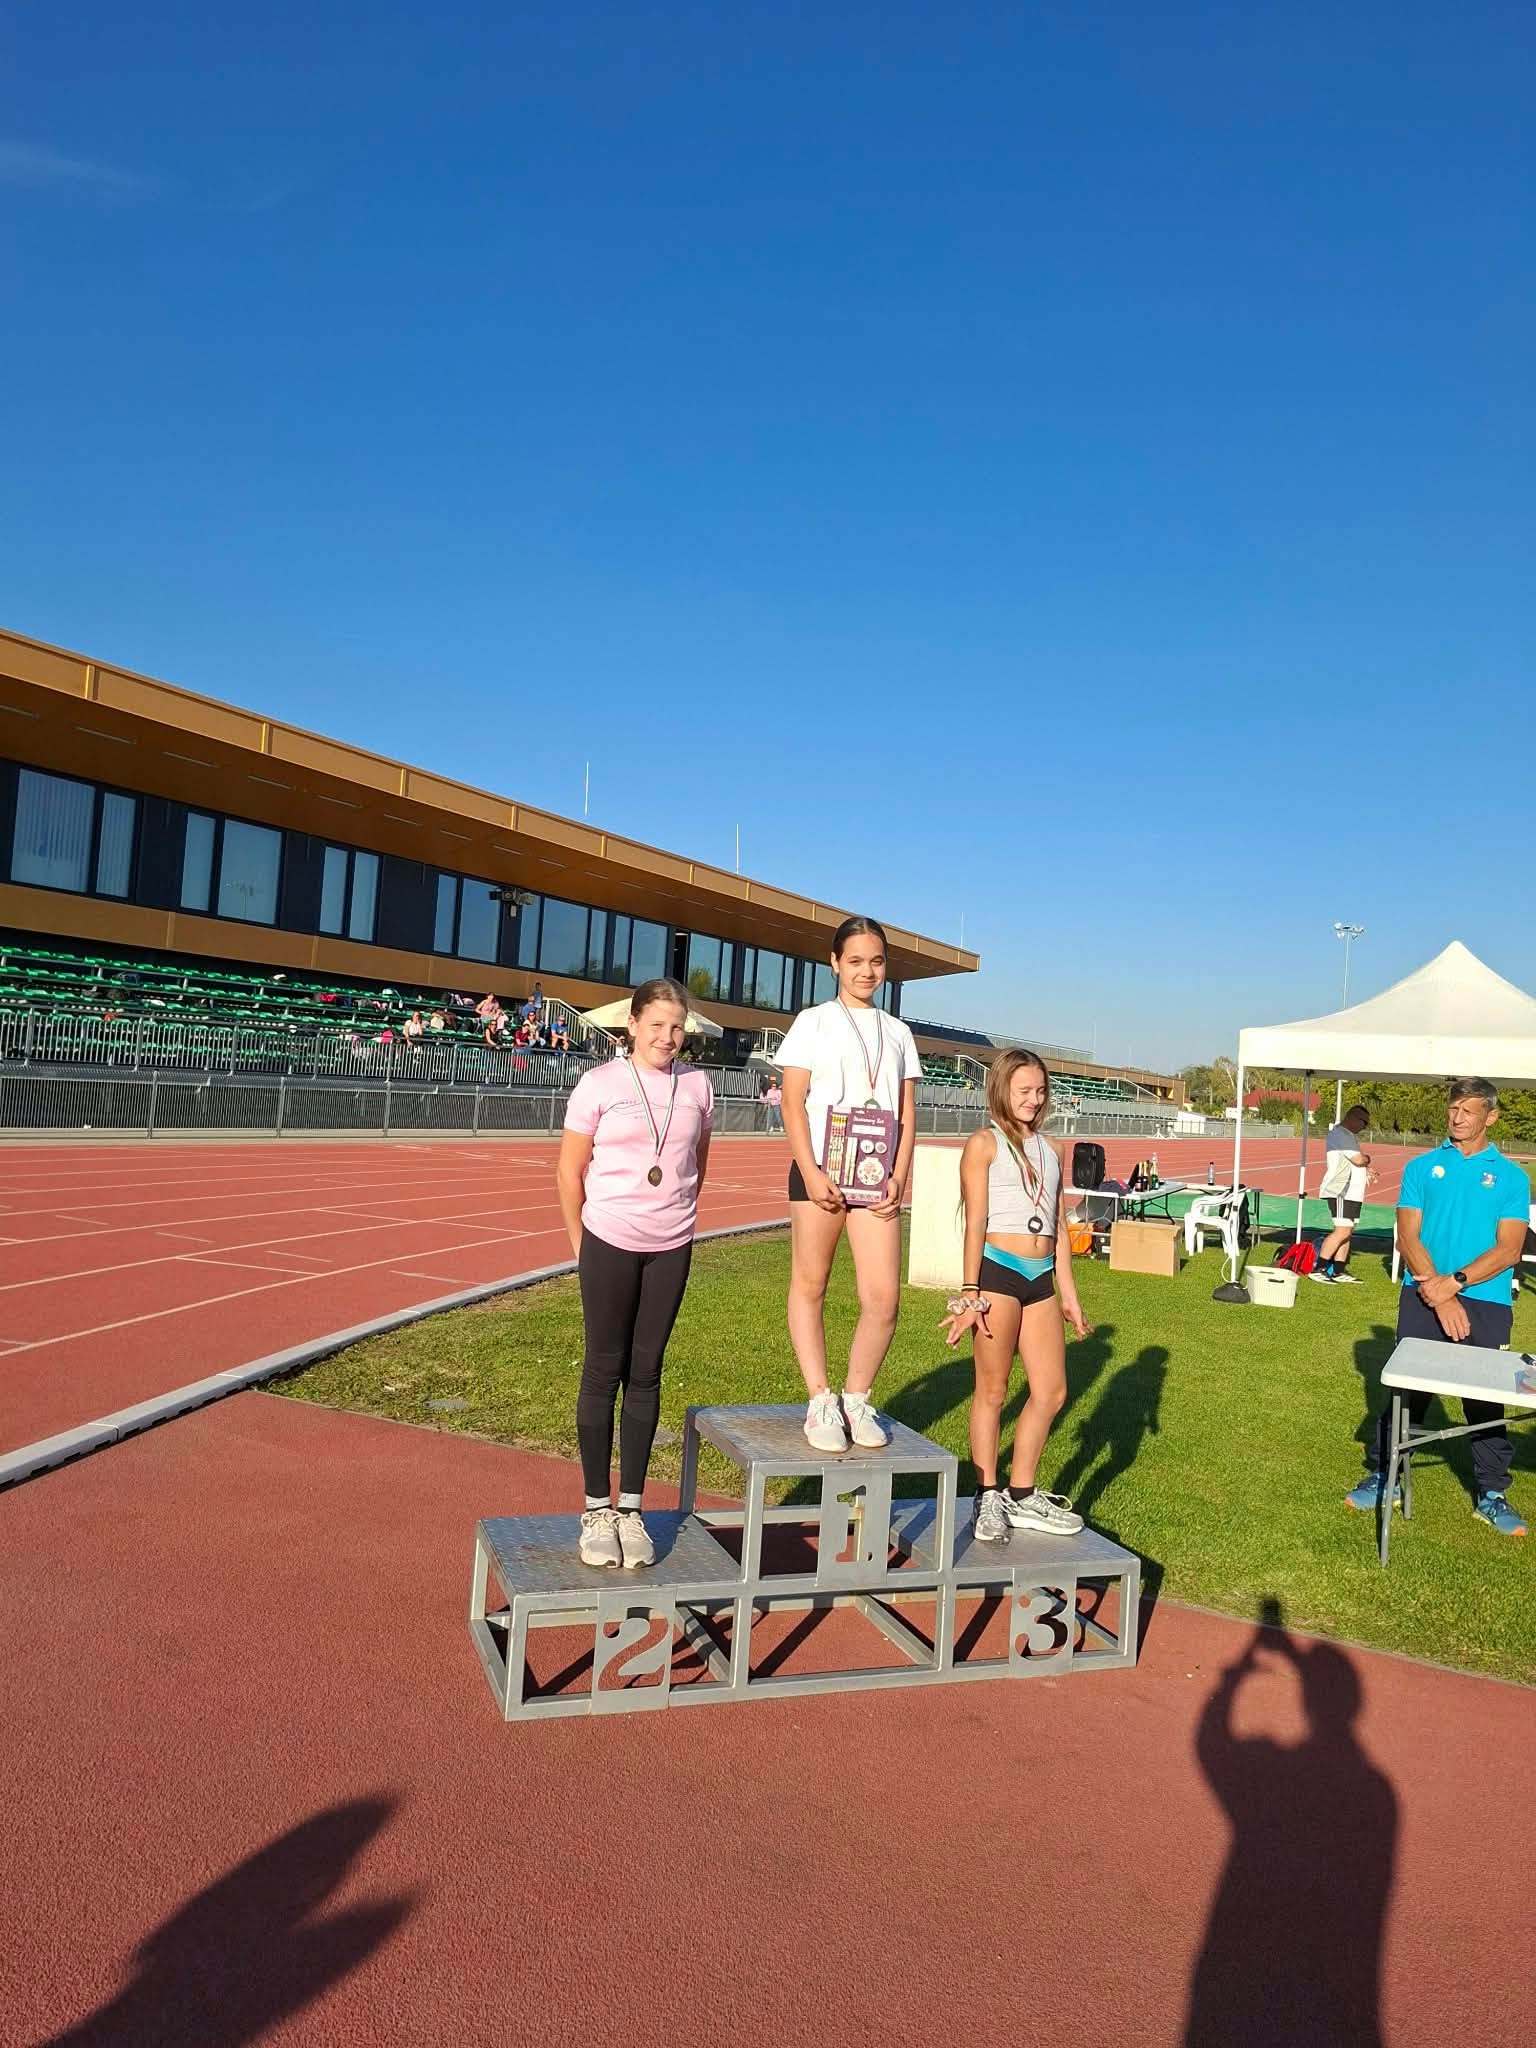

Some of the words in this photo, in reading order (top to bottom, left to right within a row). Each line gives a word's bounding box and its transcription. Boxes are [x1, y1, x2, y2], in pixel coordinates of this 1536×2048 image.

[836, 1485, 873, 1562] 1
[598, 1606, 669, 1691] 2
[1015, 1586, 1068, 1661] 3
